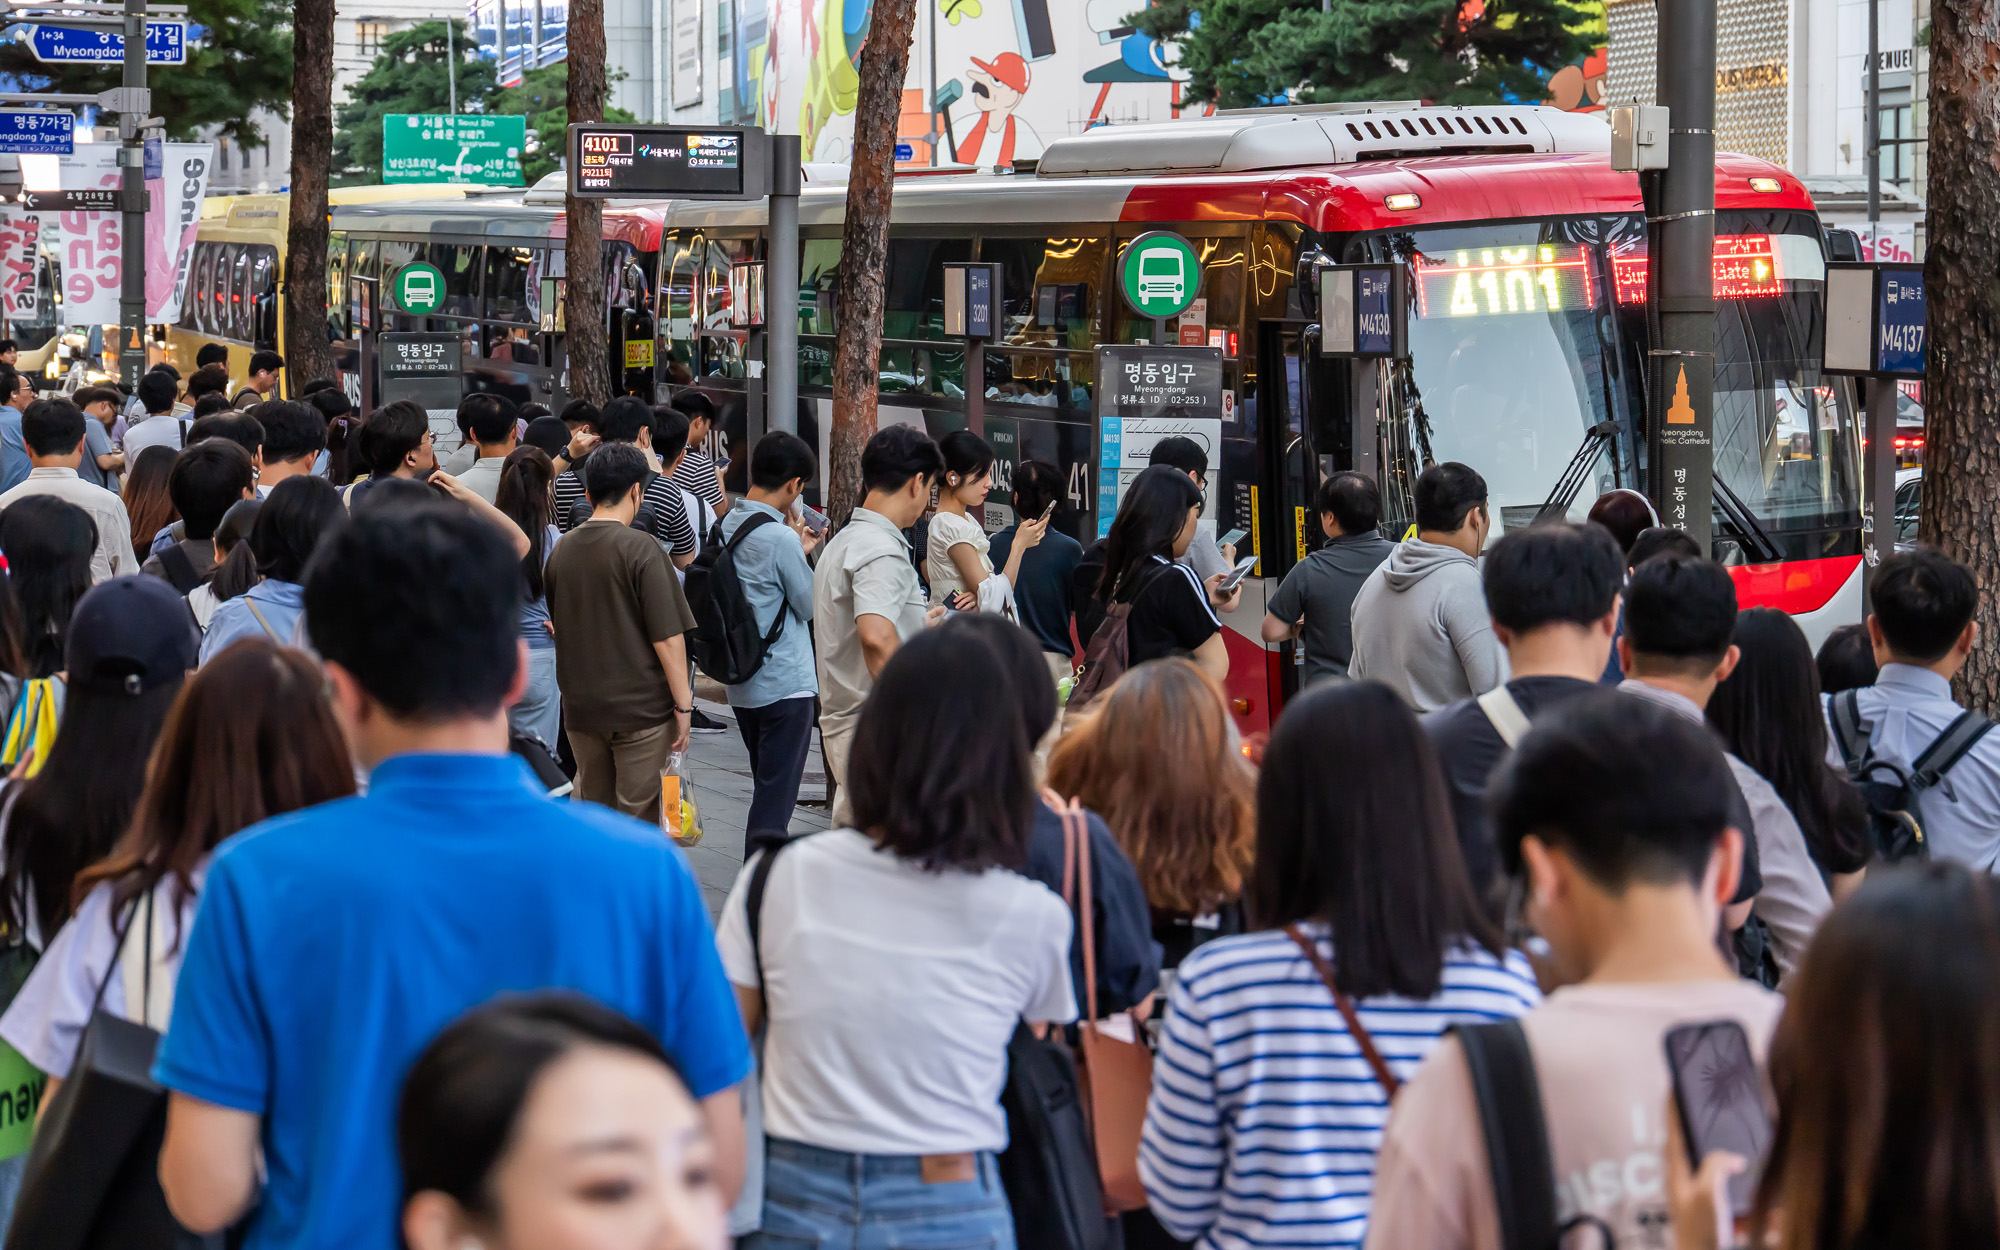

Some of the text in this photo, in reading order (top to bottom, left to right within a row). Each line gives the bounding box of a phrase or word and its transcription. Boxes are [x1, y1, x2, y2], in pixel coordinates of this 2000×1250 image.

[53, 31, 64, 40] 34
[54, 45, 179, 61] Myeongdon ga-gil
[14, 115, 71, 131] 명동7가길
[0, 132, 71, 143] ngdong 7ga-gil
[584, 137, 619, 152] 4101
[649, 148, 682, 157] 서울특별시
[584, 155, 605, 165] 곧도착
[1900, 287, 1922, 300] 줄서는 곳
[973, 304, 988, 323] 3201
[1360, 313, 1390, 335] M4130
[1881, 325, 1924, 353] M4137
[397, 343, 445, 358] 명동입구
[1125, 363, 1196, 384] 명동입구
[1134, 385, 1186, 395] Myeong-dong
[1121, 395, 1146, 404] 정류소
[1150, 396, 1160, 404] ID
[1171, 396, 1200, 404] 02-253
[1678, 437, 1710, 445] Cathedral
